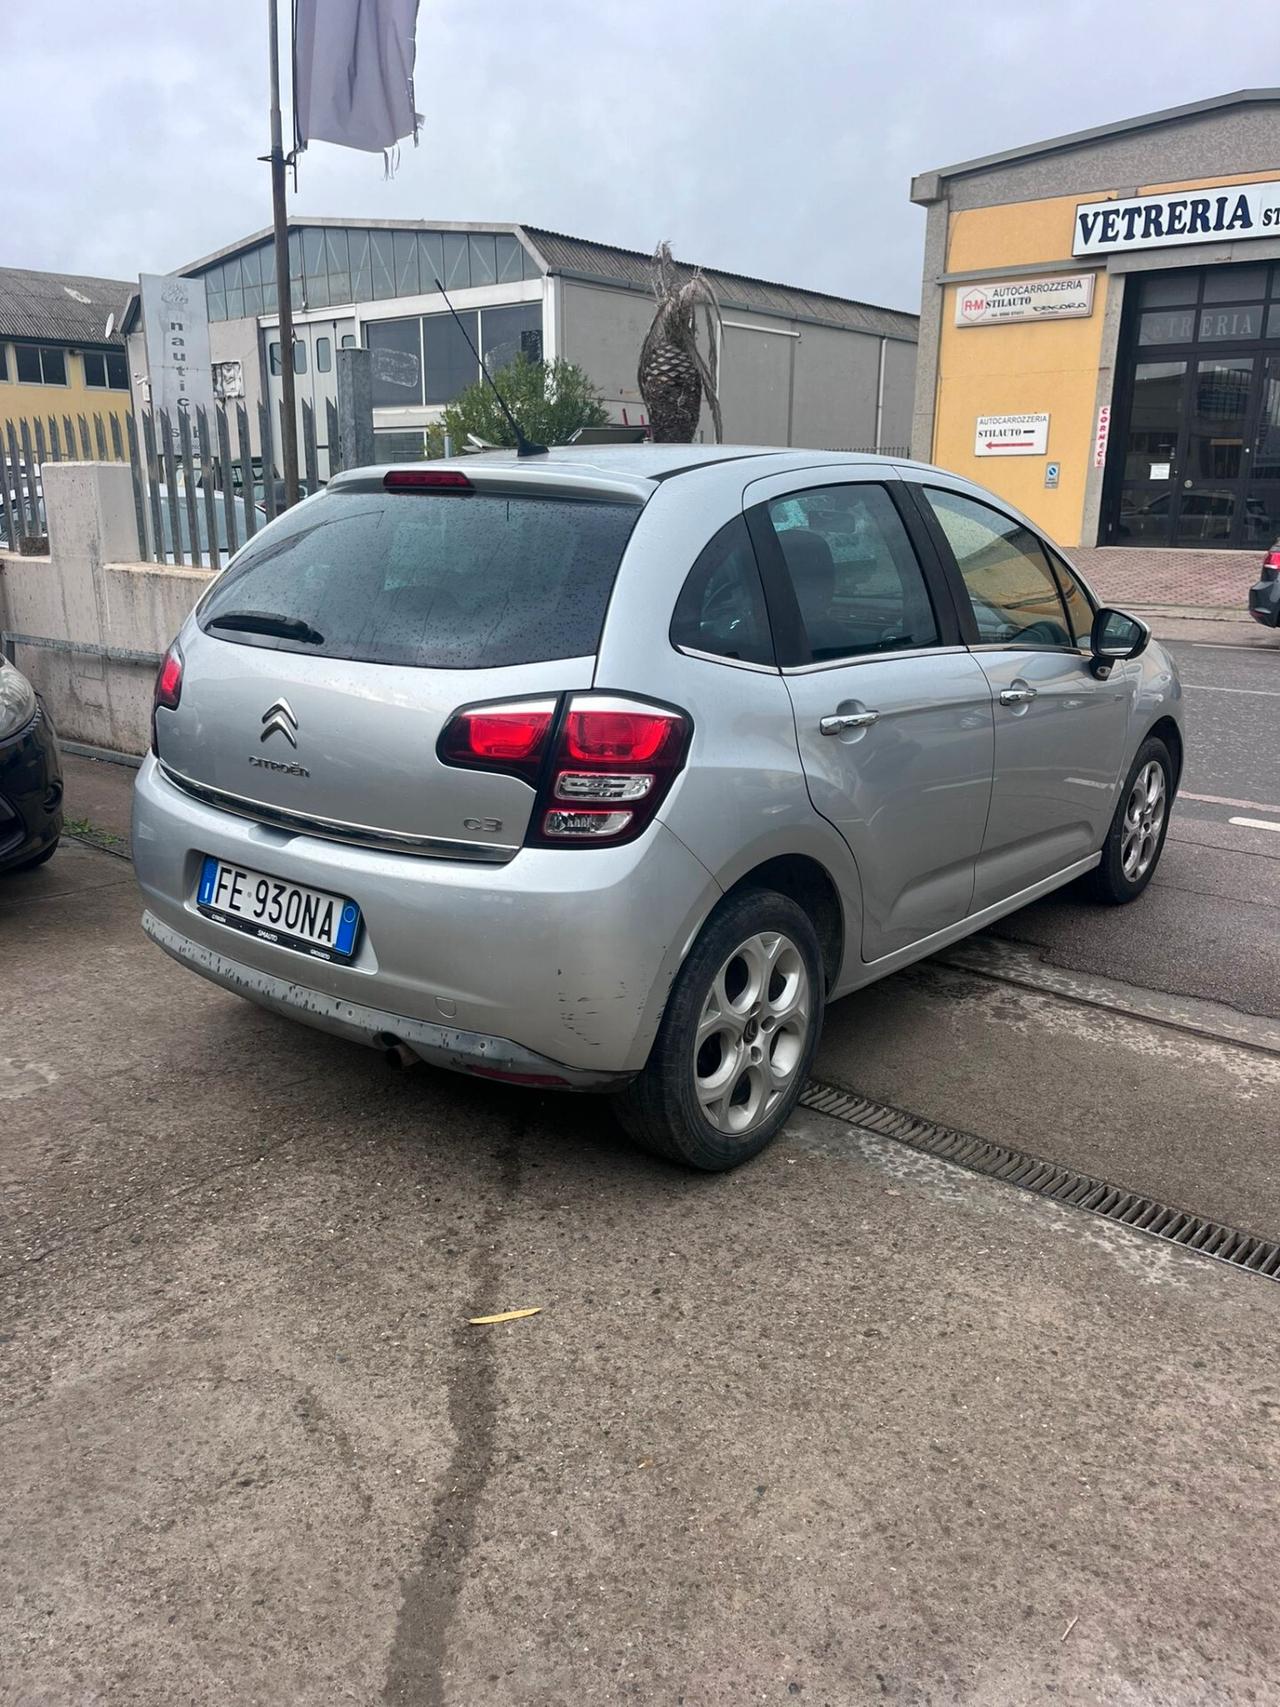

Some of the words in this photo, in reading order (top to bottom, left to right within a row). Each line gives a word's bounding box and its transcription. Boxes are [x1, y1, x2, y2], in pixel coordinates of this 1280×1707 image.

[1078, 194, 1254, 246] VETRERIA
[992, 280, 1082, 298] AUTOCARROZZERIA
[985, 296, 1031, 309] STILAUTO
[1146, 313, 1252, 340] ETRERIA
[979, 415, 1048, 426] AUTOCARROZZERIA
[978, 428, 1021, 438] STILAUTO
[463, 816, 503, 832] C3
[214, 867, 247, 911] FE
